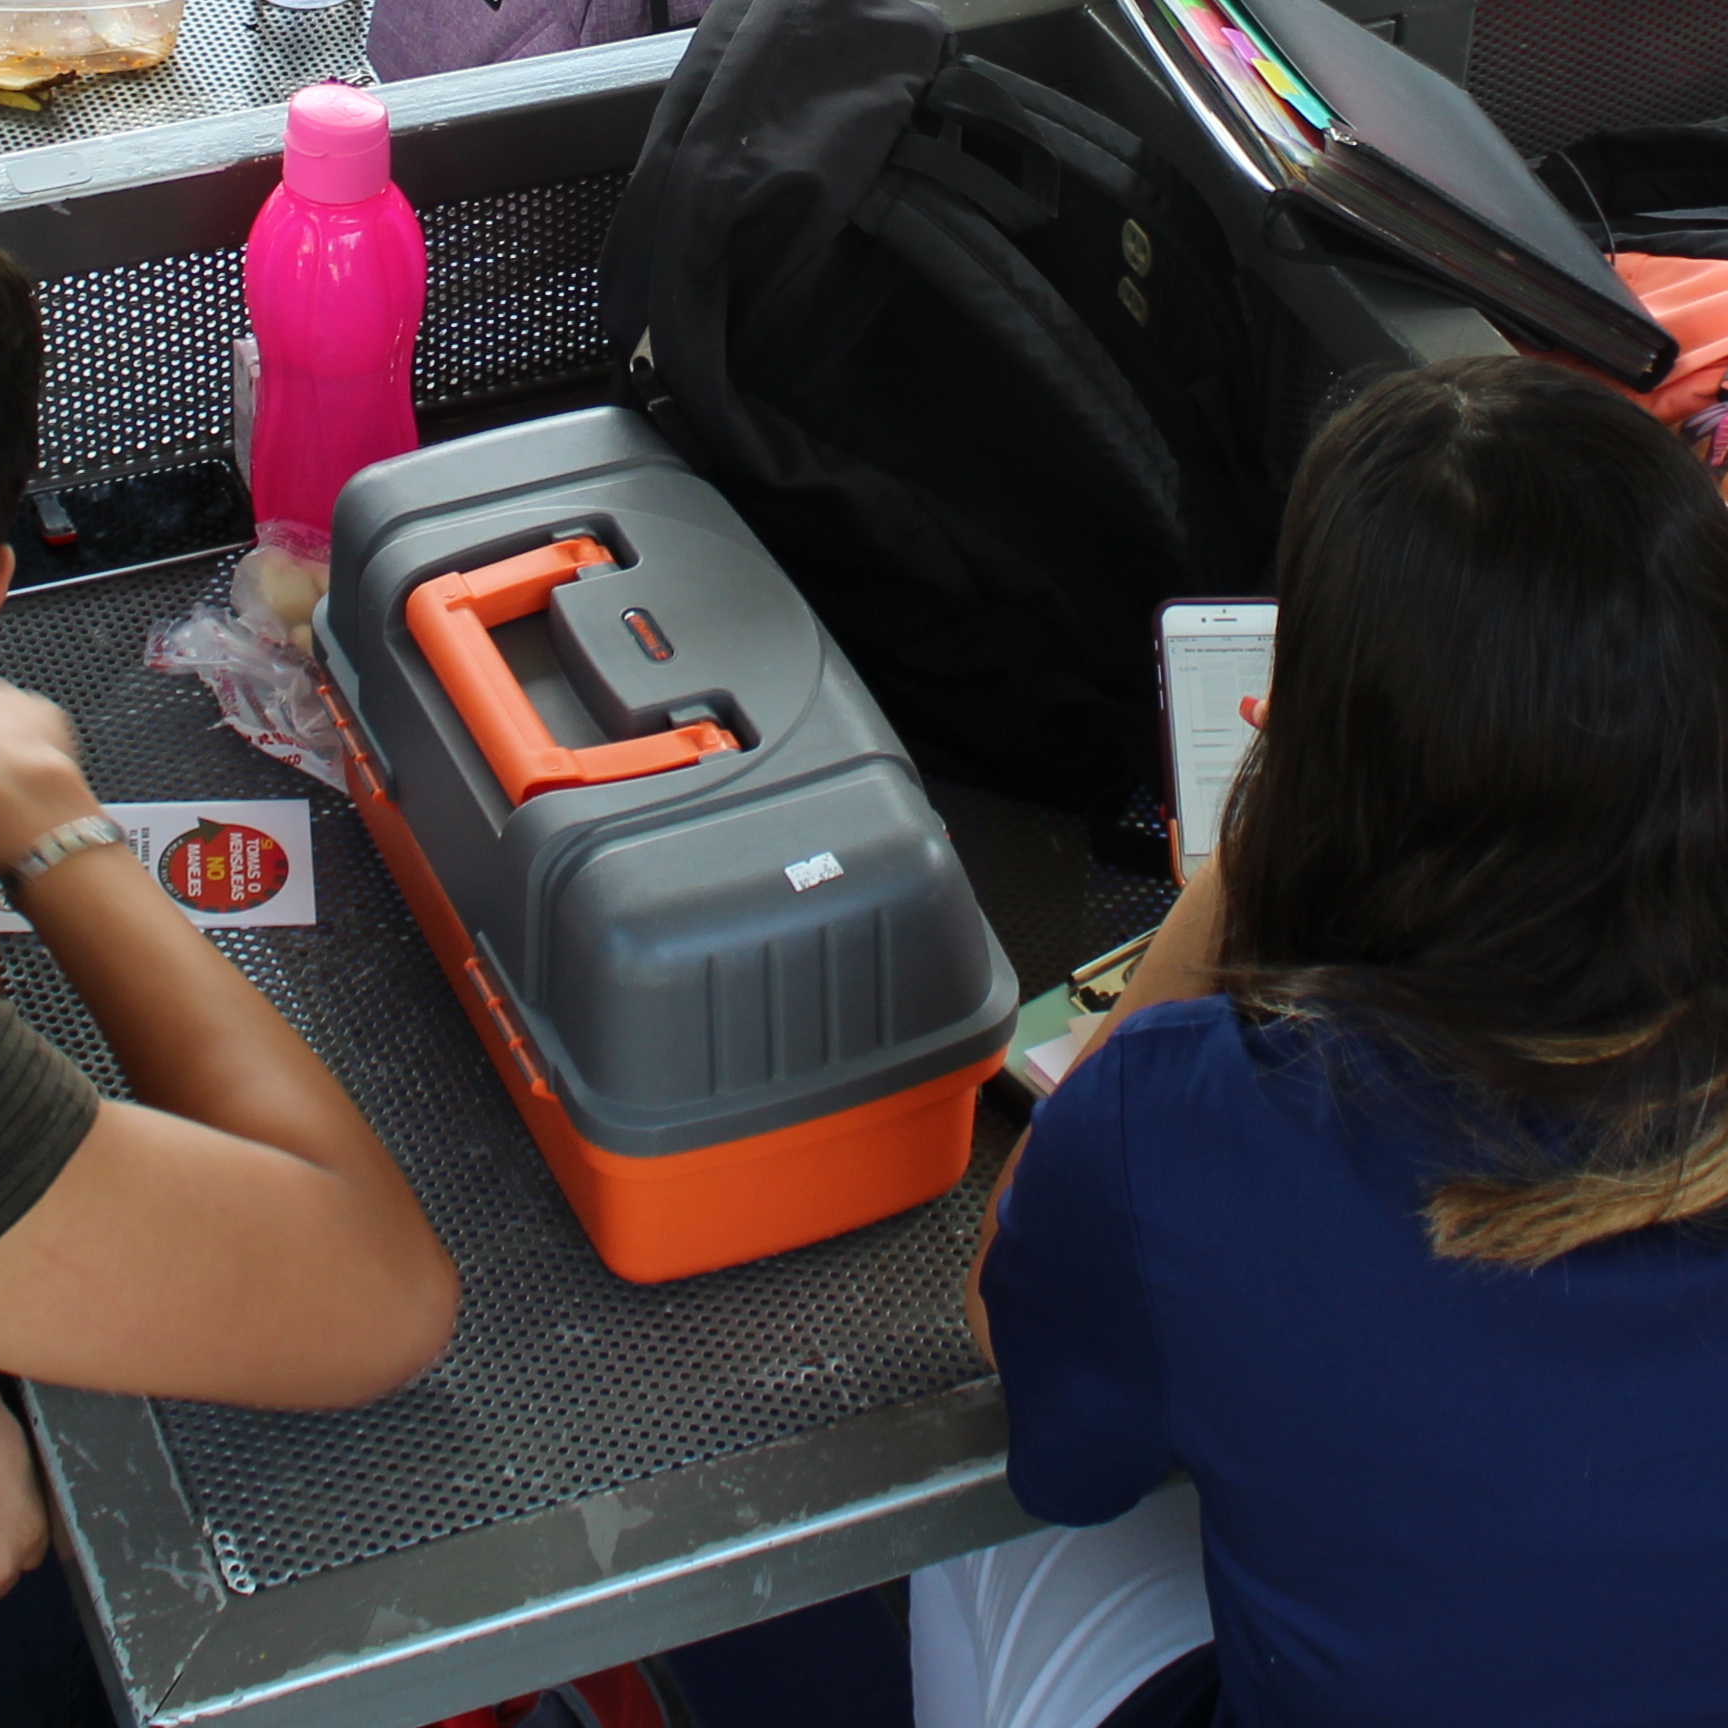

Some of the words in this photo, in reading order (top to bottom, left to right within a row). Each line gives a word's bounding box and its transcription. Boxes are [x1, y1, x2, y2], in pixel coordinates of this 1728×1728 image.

[244, 838, 261, 879] TOMAS
[260, 837, 273, 849] SI
[183, 843, 203, 897] MANEJES
[205, 856, 225, 880] NO
[226, 832, 246, 901] MENSAJEAS
[246, 882, 260, 893] O
